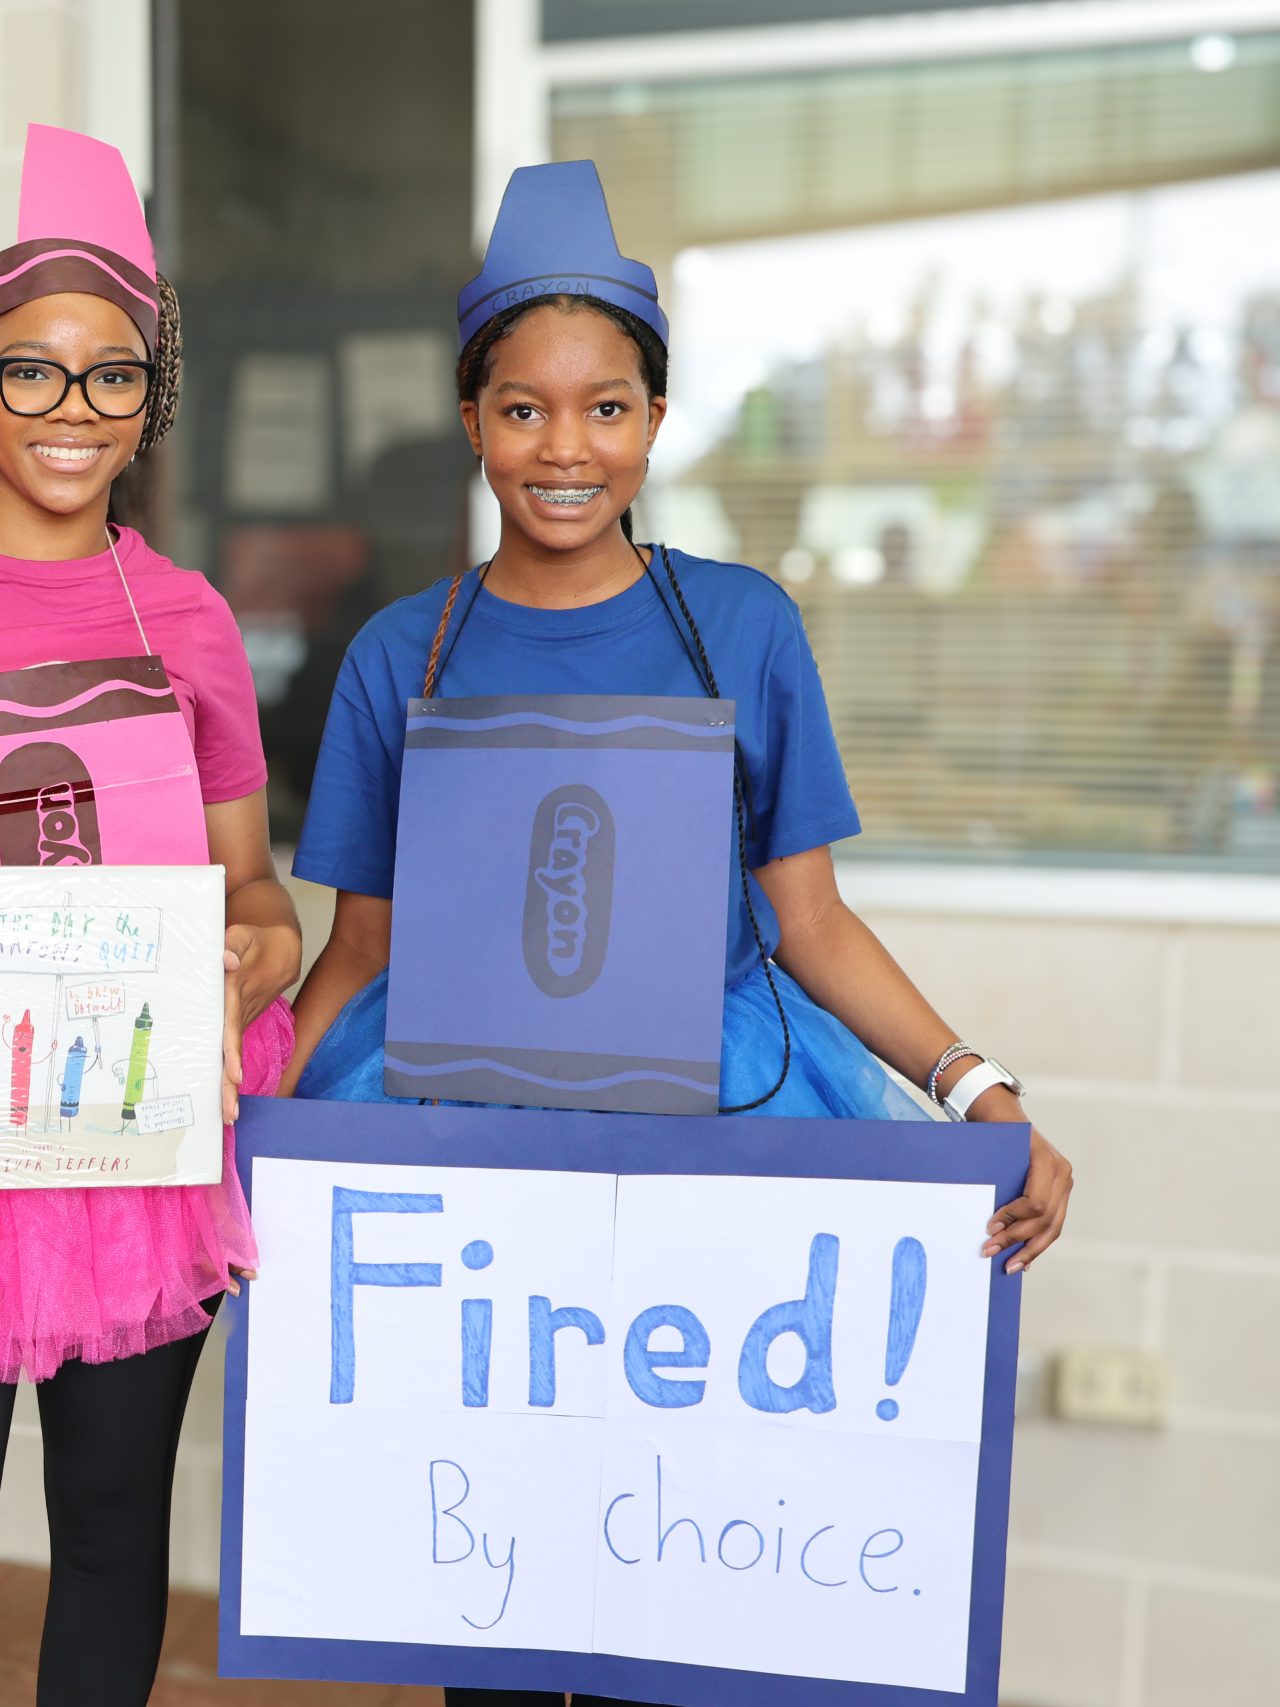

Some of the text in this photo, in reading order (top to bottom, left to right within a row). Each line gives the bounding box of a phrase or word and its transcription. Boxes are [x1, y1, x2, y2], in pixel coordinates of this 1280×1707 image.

[491, 281, 591, 312] CRAYON
[115, 911, 140, 937] the
[535, 805, 598, 960] Crayon
[55, 1156, 131, 1172] JEFFERS
[329, 1185, 927, 1422] Fired!
[429, 1455, 922, 1629] By choice.
